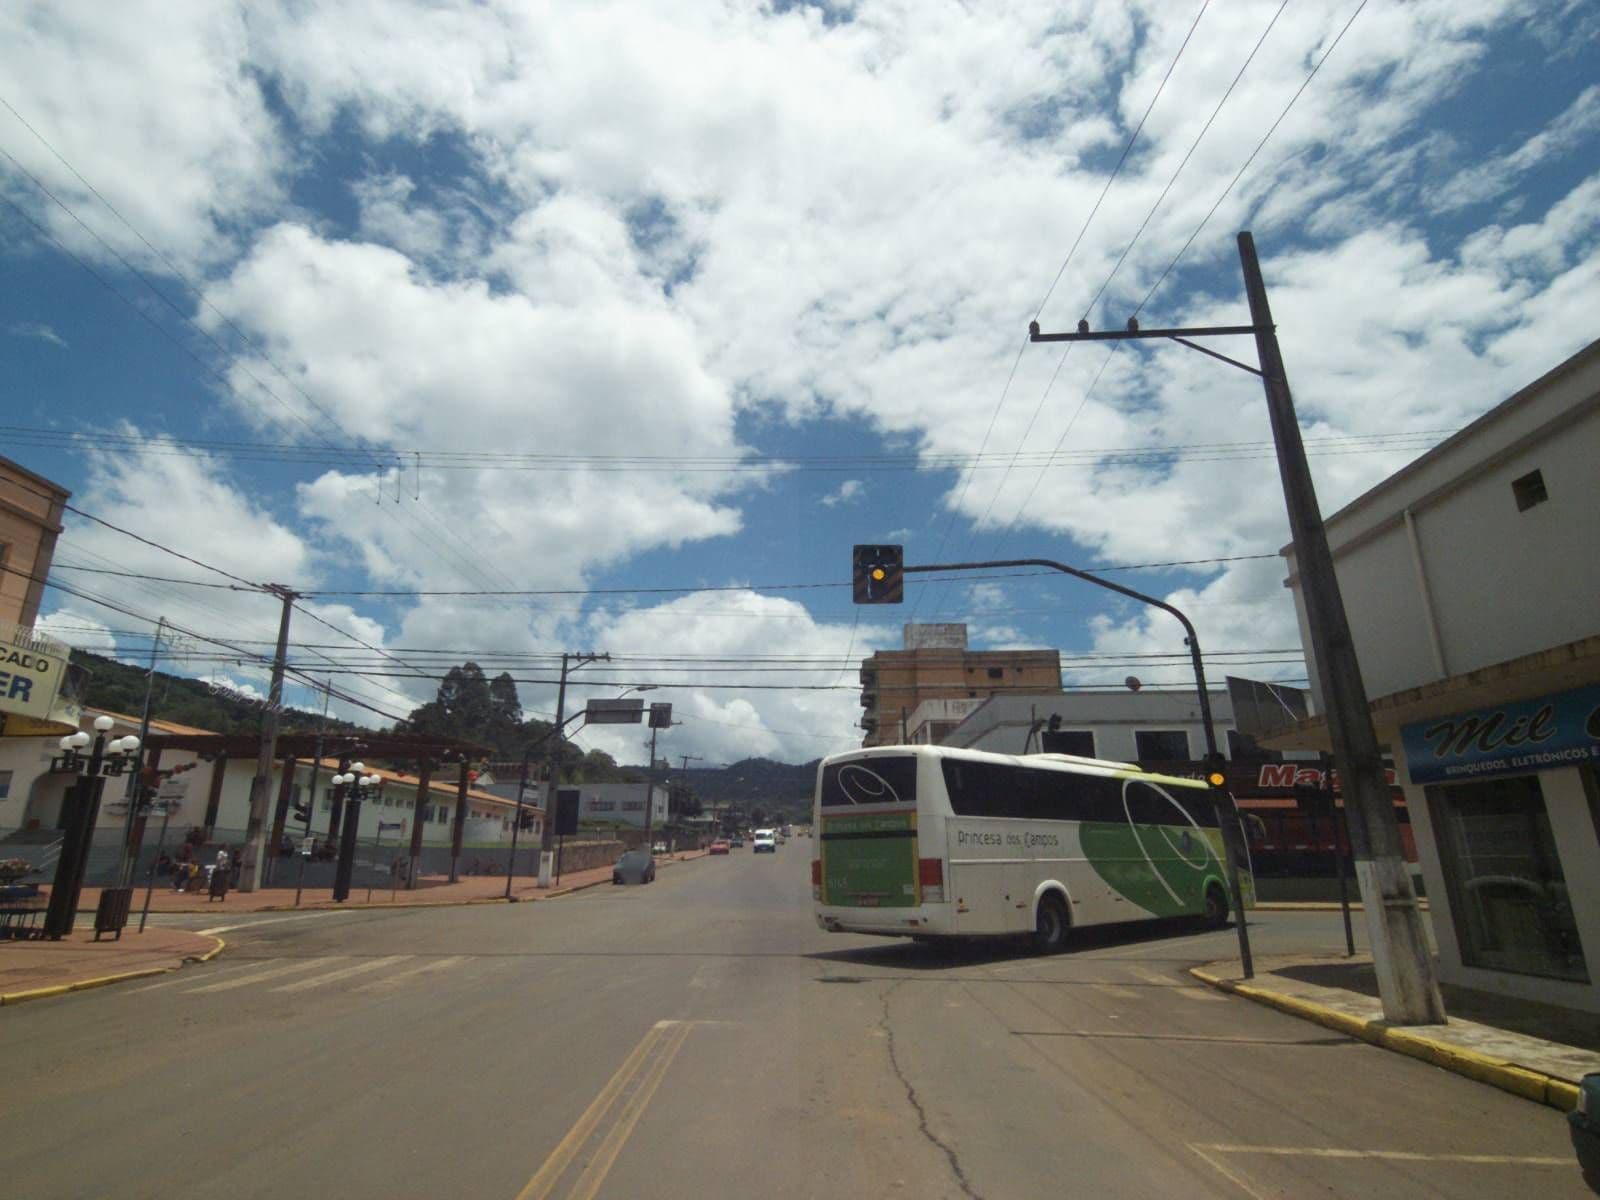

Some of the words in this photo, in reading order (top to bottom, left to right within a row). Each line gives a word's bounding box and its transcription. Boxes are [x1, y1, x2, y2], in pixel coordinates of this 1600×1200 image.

[1424, 703, 1558, 759] Mil
[957, 830, 1002, 847] Princesa
[1006, 832, 1022, 846] dos
[1024, 832, 1059, 849] Campos
